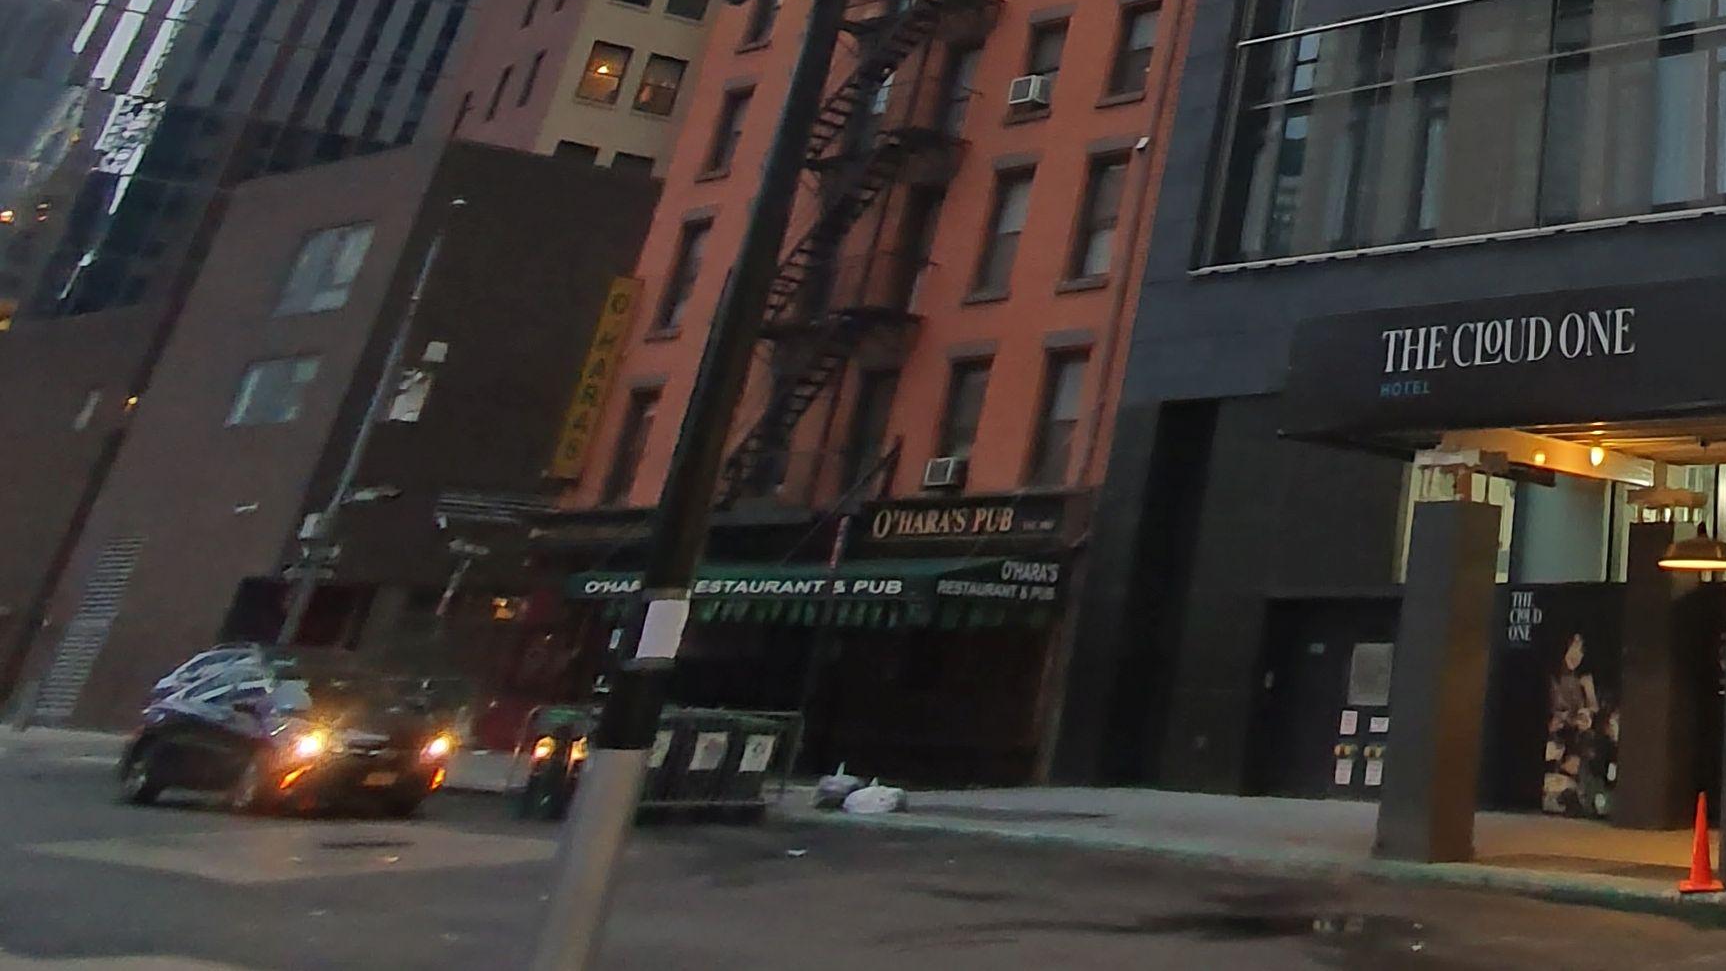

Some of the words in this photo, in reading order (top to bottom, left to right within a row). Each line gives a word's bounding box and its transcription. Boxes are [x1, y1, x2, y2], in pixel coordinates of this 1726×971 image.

[1382, 326, 1448, 373] THE
[1452, 316, 1552, 366] CLOUD
[1559, 307, 1636, 359] ONE
[1380, 381, 1432, 398] HOTEL
[873, 508, 966, 539] O'HARA'S
[971, 506, 1015, 533] PUB
[1000, 561, 1059, 583] O'HARA'S
[686, 579, 824, 599] ESTAURANT
[852, 580, 903, 595] PUB
[936, 580, 1017, 598] RESTAURANT
[1029, 586, 1057, 601] PUB
[1507, 624, 1533, 642] ONE
